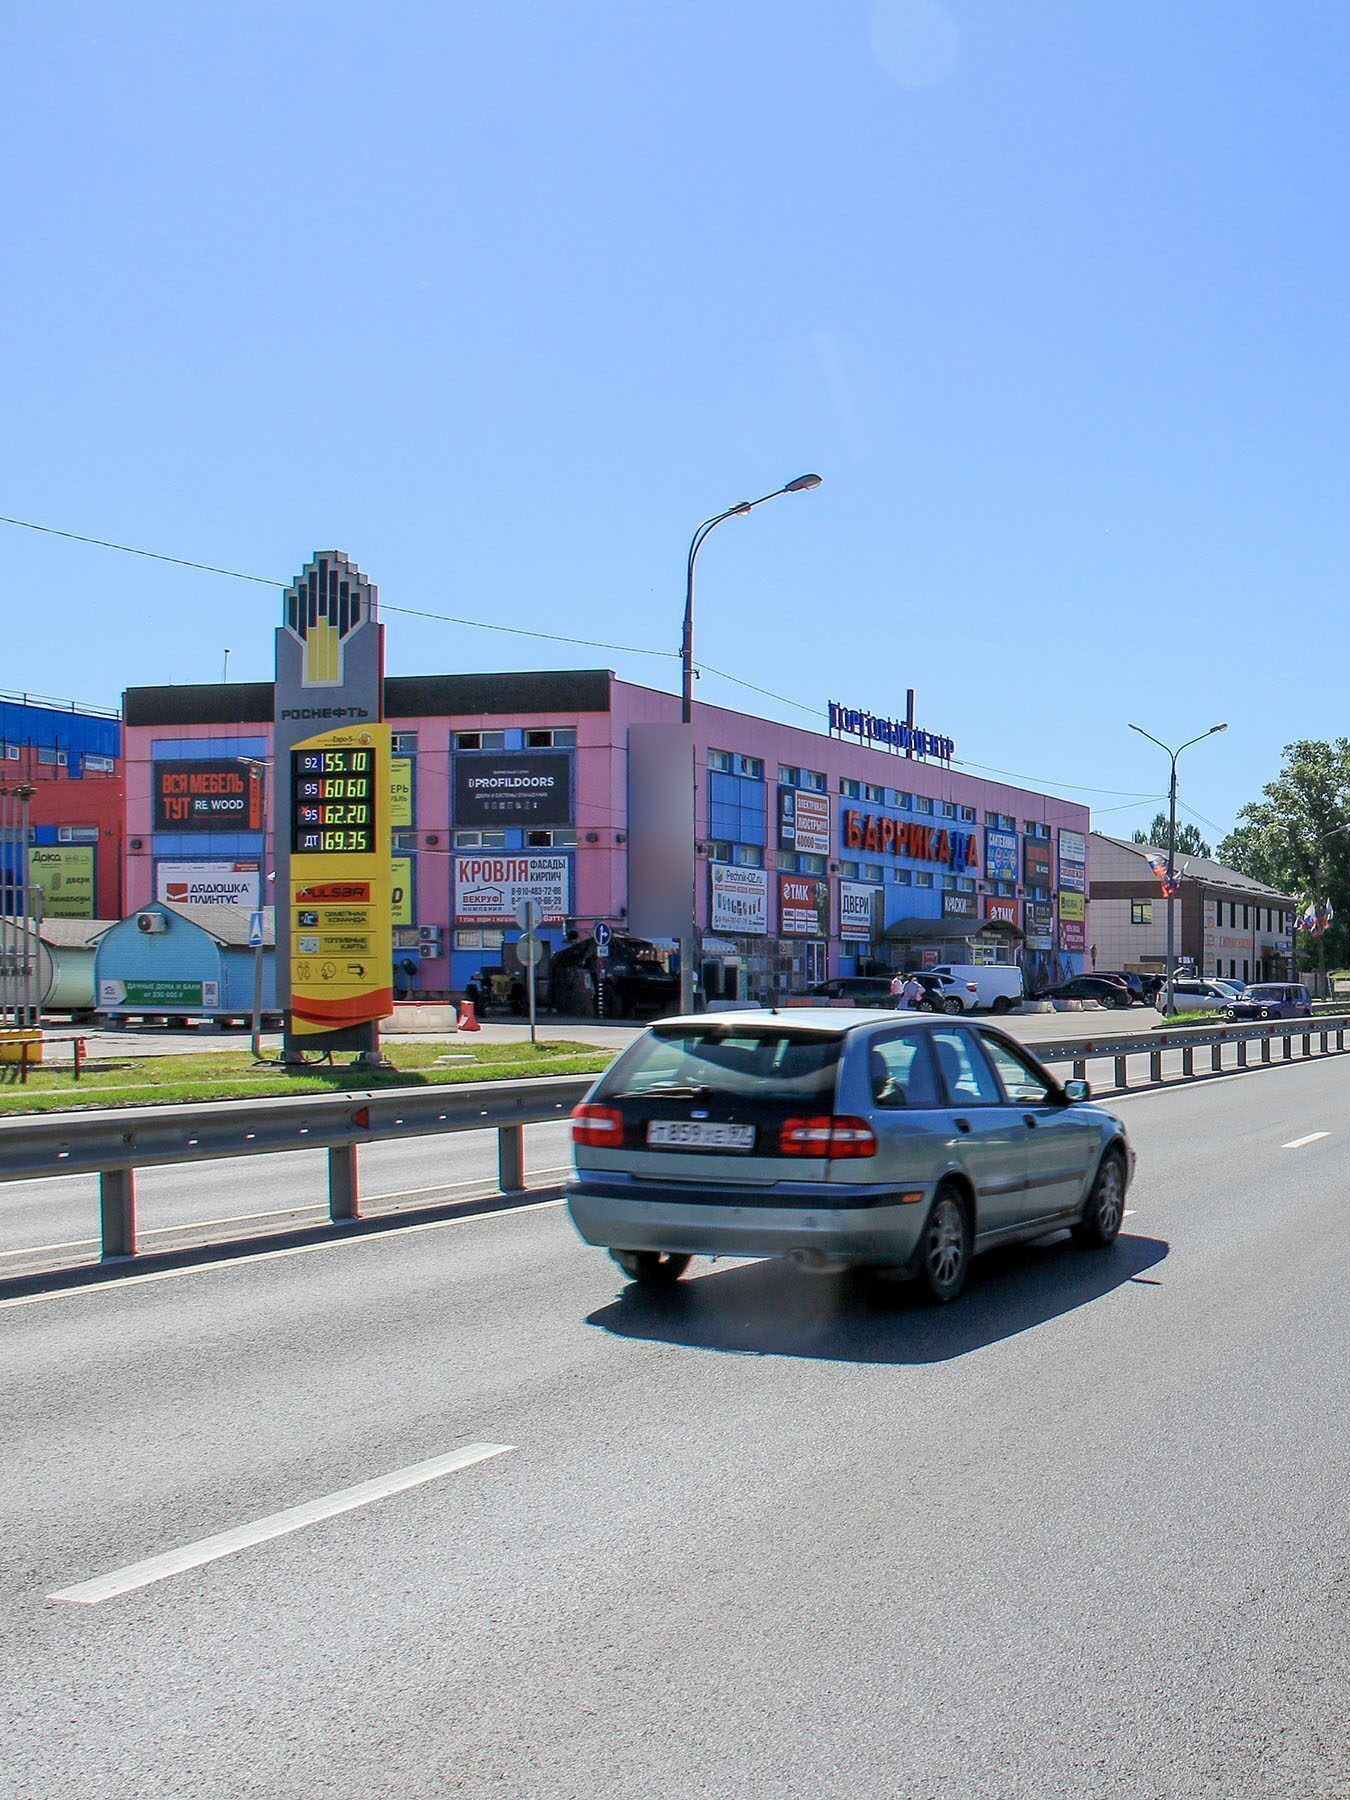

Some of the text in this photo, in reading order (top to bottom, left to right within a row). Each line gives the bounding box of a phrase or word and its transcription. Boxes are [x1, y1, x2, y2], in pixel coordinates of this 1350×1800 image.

[281, 707, 369, 720] РОСНЕФТЬ
[304, 758, 318, 769] 92
[162, 773, 244, 794] ВСЯ МЕБЕЛЬ
[304, 783, 318, 795] 95
[163, 797, 191, 819] ТУТ
[195, 800, 244, 810] RE WOOD
[304, 805, 367, 824] 95 62.20
[304, 831, 367, 850] ДТ 69.35
[845, 810, 979, 872] БАРРИКАДА
[32, 851, 61, 863] Дока
[460, 859, 566, 882] КРОВЛЯ ФАСАДЫ
[530, 872, 561, 881] КИРПИЧ
[190, 883, 249, 893] ДЯДЮШКА
[190, 895, 238, 904] ПЛИНТУС
[843, 895, 869, 914] ДВЕРИ
